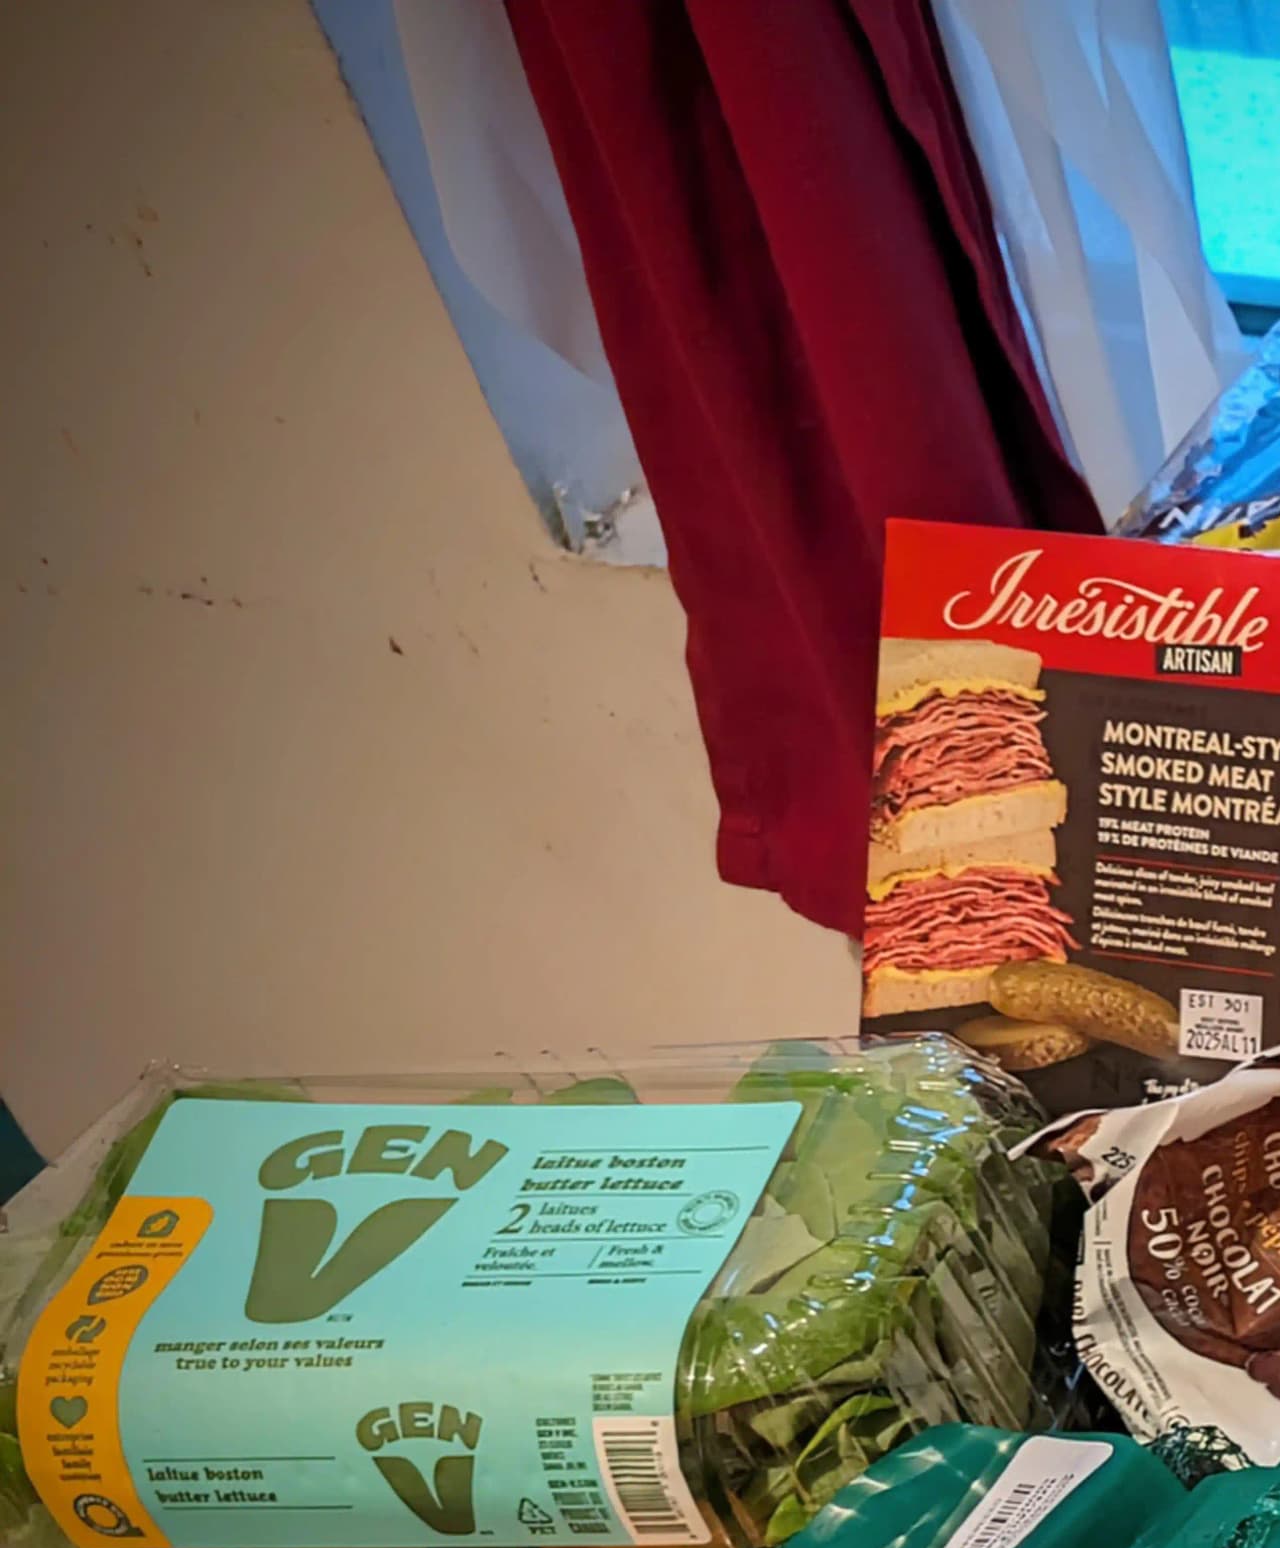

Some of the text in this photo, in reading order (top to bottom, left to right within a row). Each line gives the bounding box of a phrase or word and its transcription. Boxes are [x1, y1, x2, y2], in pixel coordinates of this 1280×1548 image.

[944, 548, 1270, 653] Irrésistible
[1162, 647, 1235, 676] ARTISAN
[1101, 752, 1274, 793] SMOKED MEAT
[1099, 783, 1168, 812] STYLE
[1156, 823, 1210, 841] PROTEIN
[1230, 846, 1279, 864] VIANDE
[258, 1124, 510, 1191] GEN
[531, 1154, 686, 1170] laitue boston
[520, 1175, 685, 1192] butter lettuce
[497, 1203, 532, 1235] 2
[244, 1197, 461, 1325] V
[1186, 1218, 1230, 1299] NOIR
[154, 1336, 385, 1355] manger selon valeurs
[176, 1353, 353, 1373] true your values
[356, 1402, 483, 1452] GEN
[204, 1466, 264, 1481] boston
[372, 1454, 475, 1536] V
